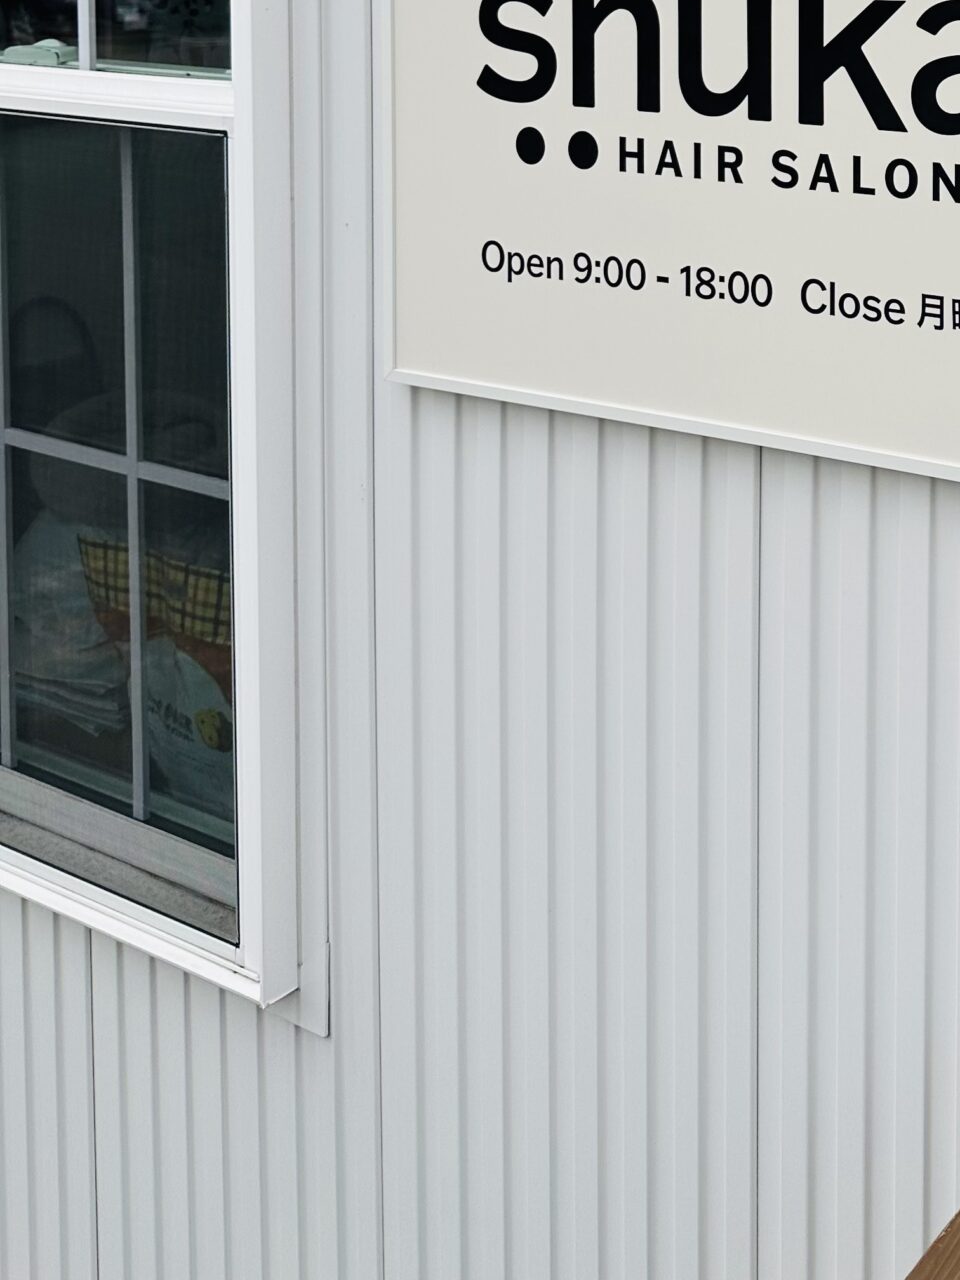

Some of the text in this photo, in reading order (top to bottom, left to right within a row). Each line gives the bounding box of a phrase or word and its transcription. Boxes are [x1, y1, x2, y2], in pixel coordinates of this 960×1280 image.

[619, 136, 744, 184] HAIR
[481, 239, 564, 283] Open
[573, 252, 647, 291] 9:00
[680, 265, 773, 308] 18:00
[800, 278, 906, 326] Close
